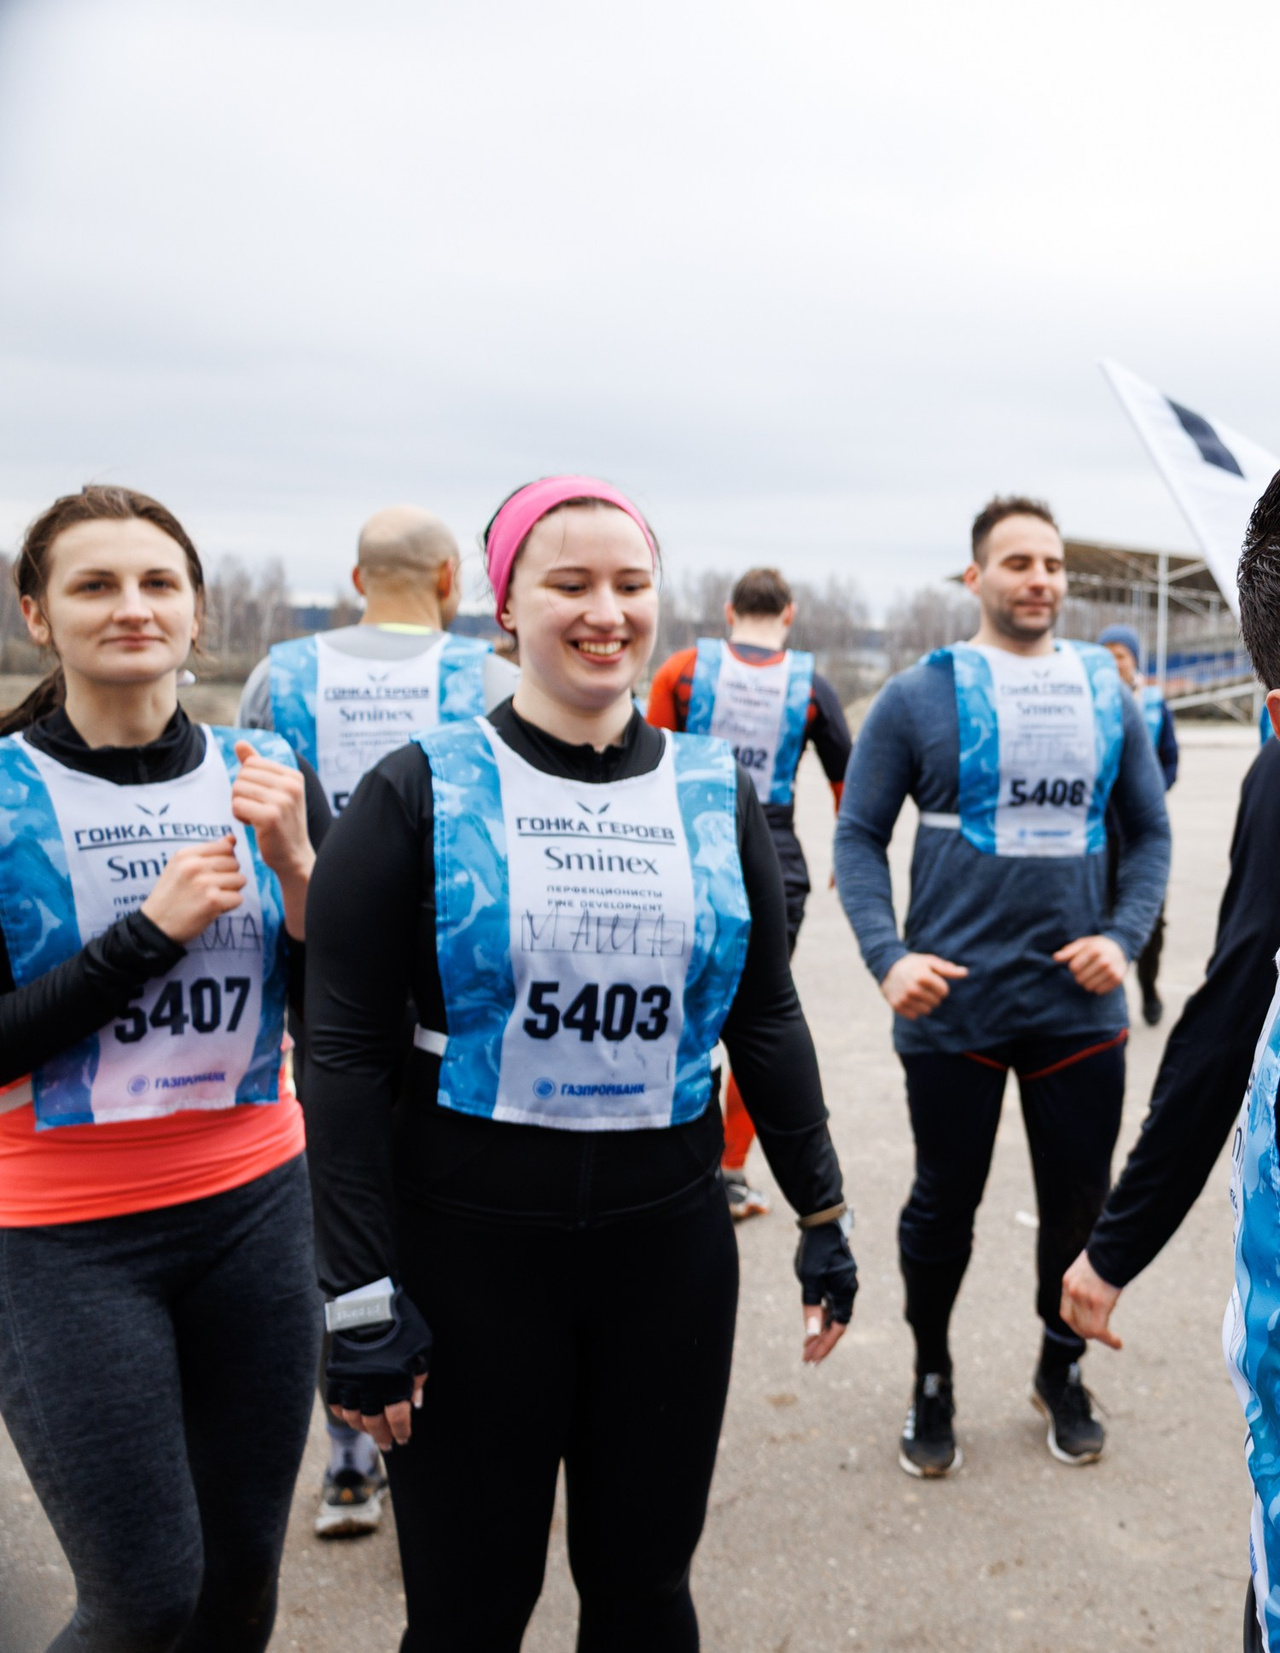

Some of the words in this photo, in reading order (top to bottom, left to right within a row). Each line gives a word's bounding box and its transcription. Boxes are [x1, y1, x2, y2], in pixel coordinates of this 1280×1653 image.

[74, 822, 153, 844] ГОНКА
[158, 822, 233, 838] ГЕРОЕВ
[516, 817, 590, 833] ГОНКА
[598, 821, 676, 840] ГЕРОЕВ
[107, 852, 168, 883] Smi
[544, 846, 660, 876] Sminex
[547, 885, 663, 898] ПЕРФЕКЦИОНИСТЫ
[580, 900, 663, 911] DEVELOPMENT
[114, 976, 251, 1044] 5407
[522, 980, 672, 1042] 5403
[560, 1083, 646, 1097] ГАЗПРОМБАНК
